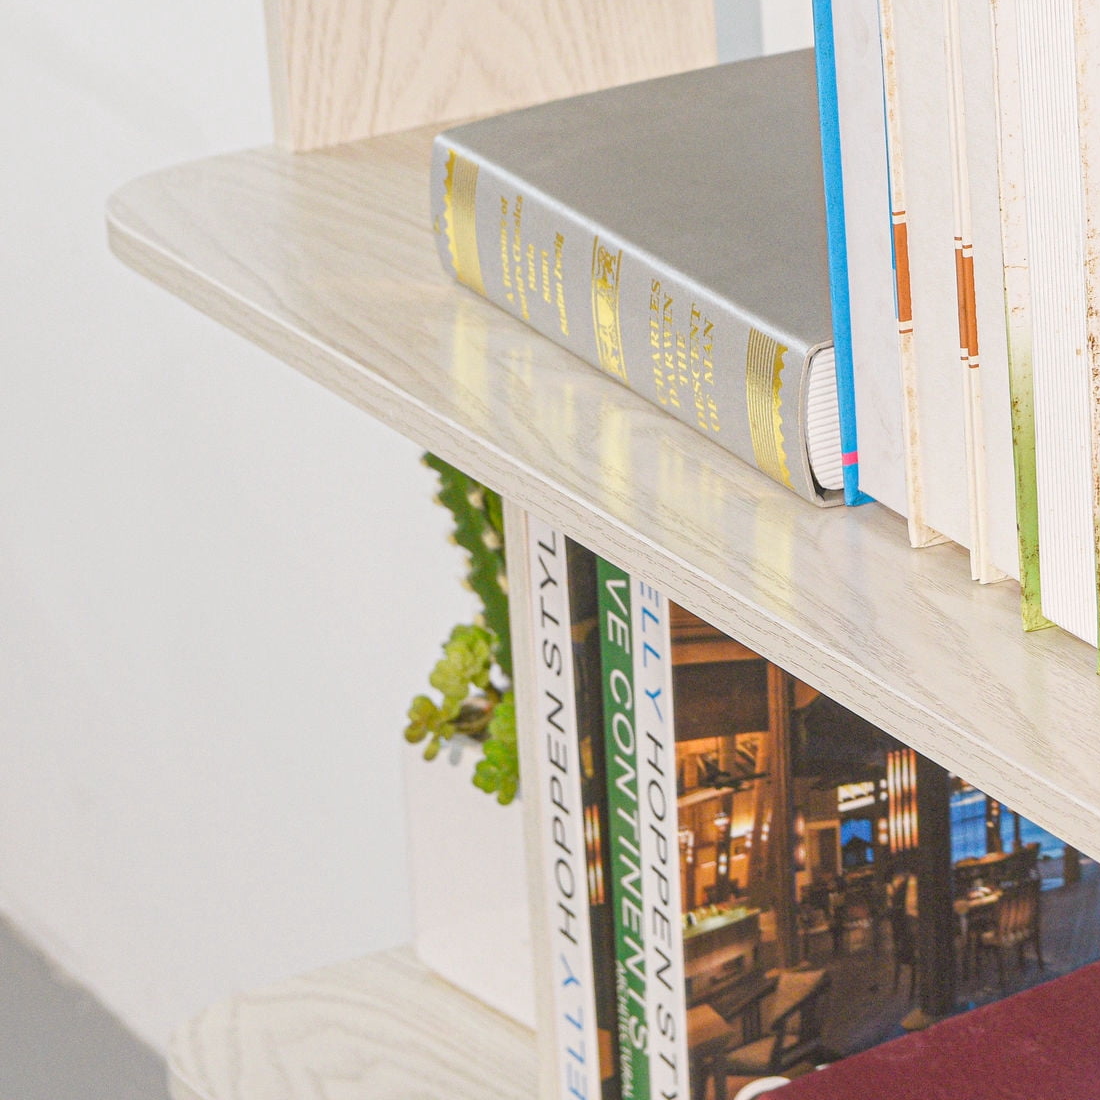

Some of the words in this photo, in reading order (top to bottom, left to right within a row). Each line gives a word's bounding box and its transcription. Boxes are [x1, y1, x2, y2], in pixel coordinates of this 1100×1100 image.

[649, 278, 668, 405] CHARLES
[662, 291, 681, 408] DARWIN
[675, 330, 688, 386] THE
[689, 302, 708, 431] DESCENT
[702, 317, 715, 386] MAN
[706, 393, 720, 433] OF
[537, 531, 563, 676] STYL
[605, 578, 631, 654] VE
[545, 691, 578, 946] HOPPEN
[609, 668, 650, 1055] CONTINENTS
[646, 731, 673, 992] HOPPEN
